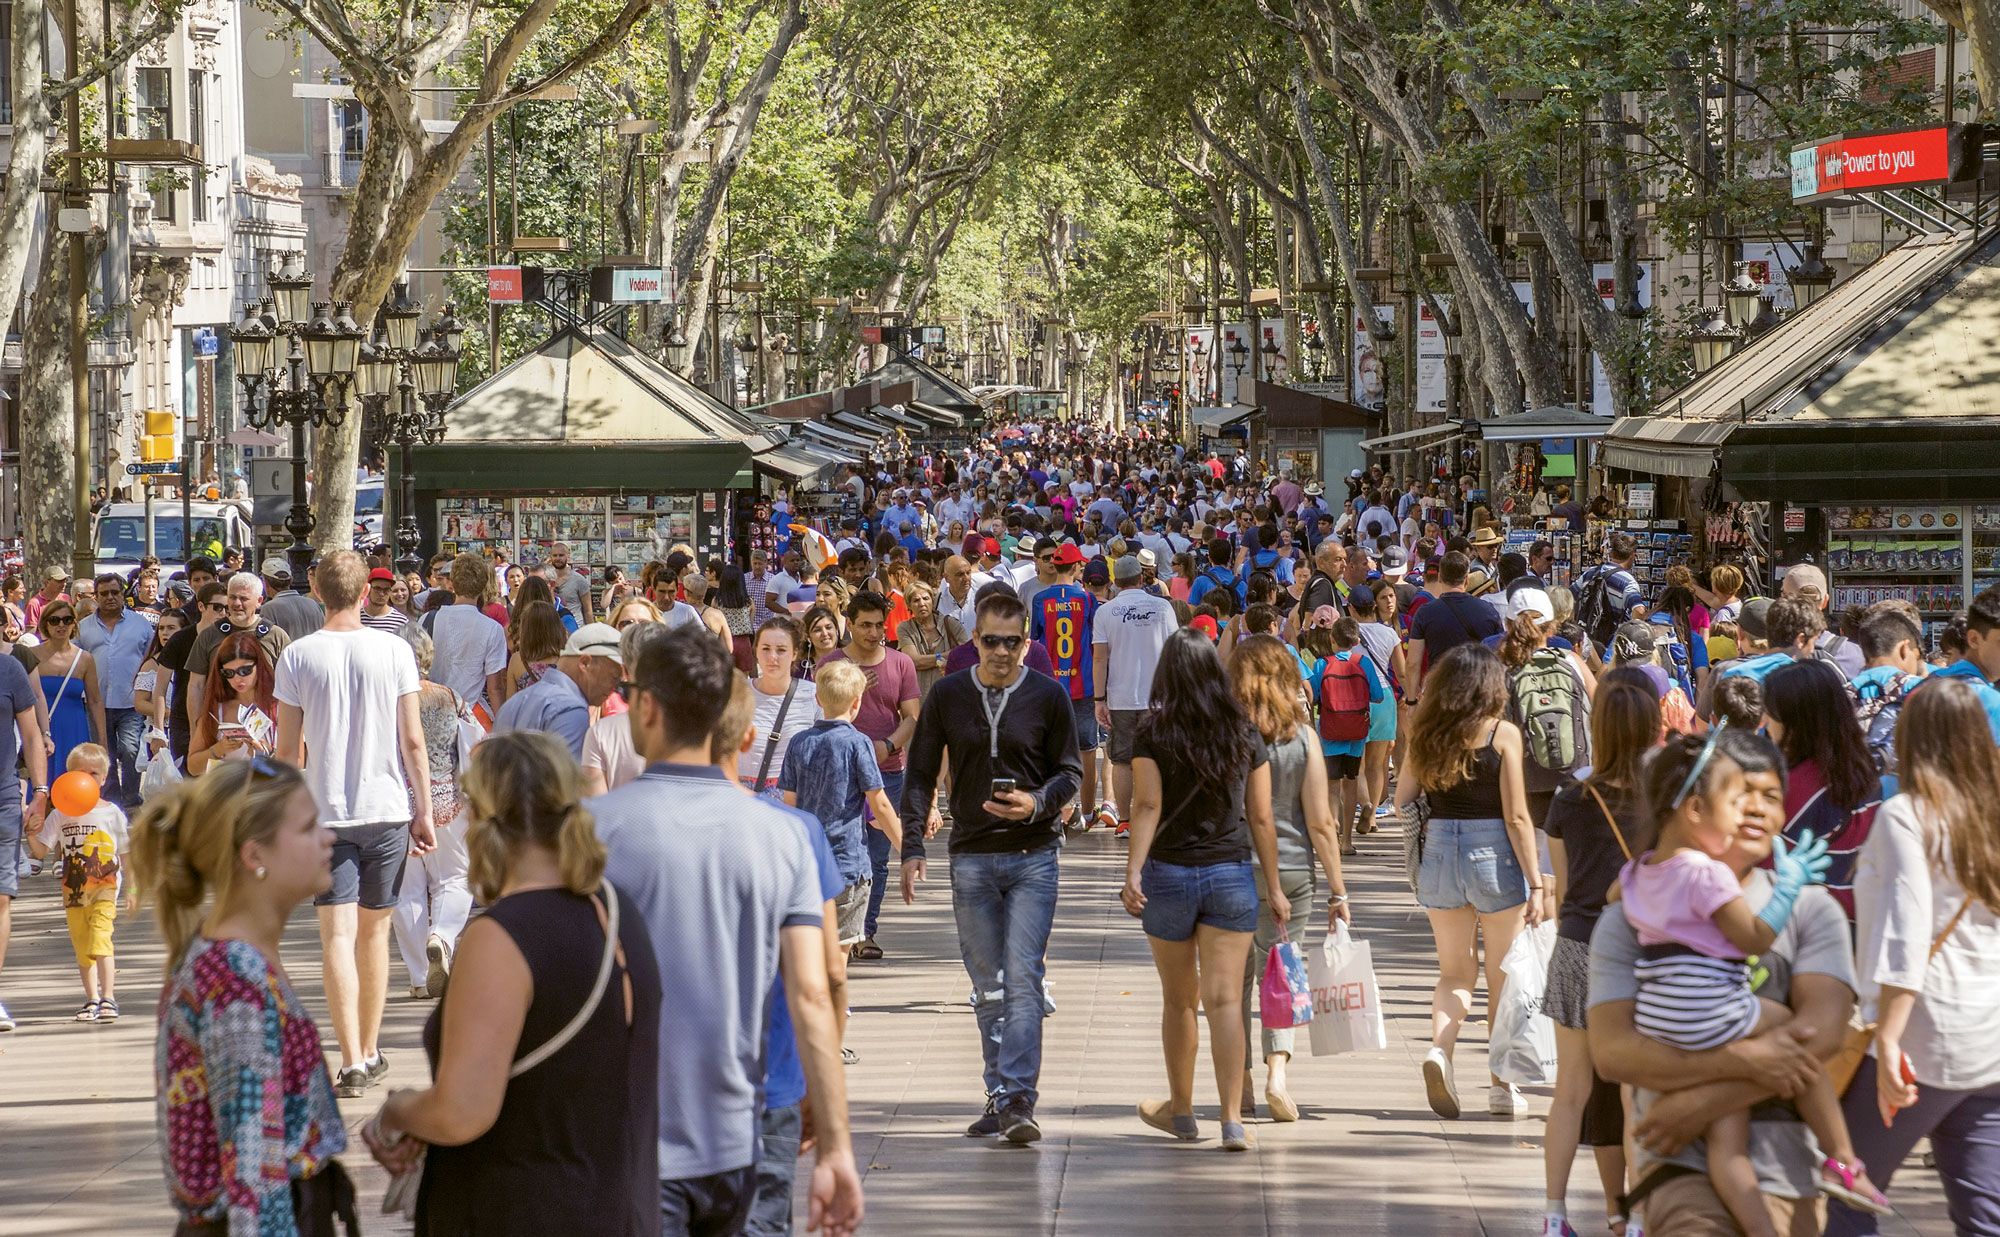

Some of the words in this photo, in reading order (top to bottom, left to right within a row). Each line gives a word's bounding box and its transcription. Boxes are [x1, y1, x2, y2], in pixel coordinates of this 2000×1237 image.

[1842, 152, 1876, 173] Power
[1879, 149, 1890, 170] to
[1892, 149, 1915, 175] you
[629, 277, 658, 292] Vodafone
[1046, 603, 1054, 613] A.
[1055, 602, 1081, 612] INIESTA
[1122, 608, 1156, 623] Ferrat
[1056, 617, 1074, 659] 8
[1053, 668, 1070, 677] nicef
